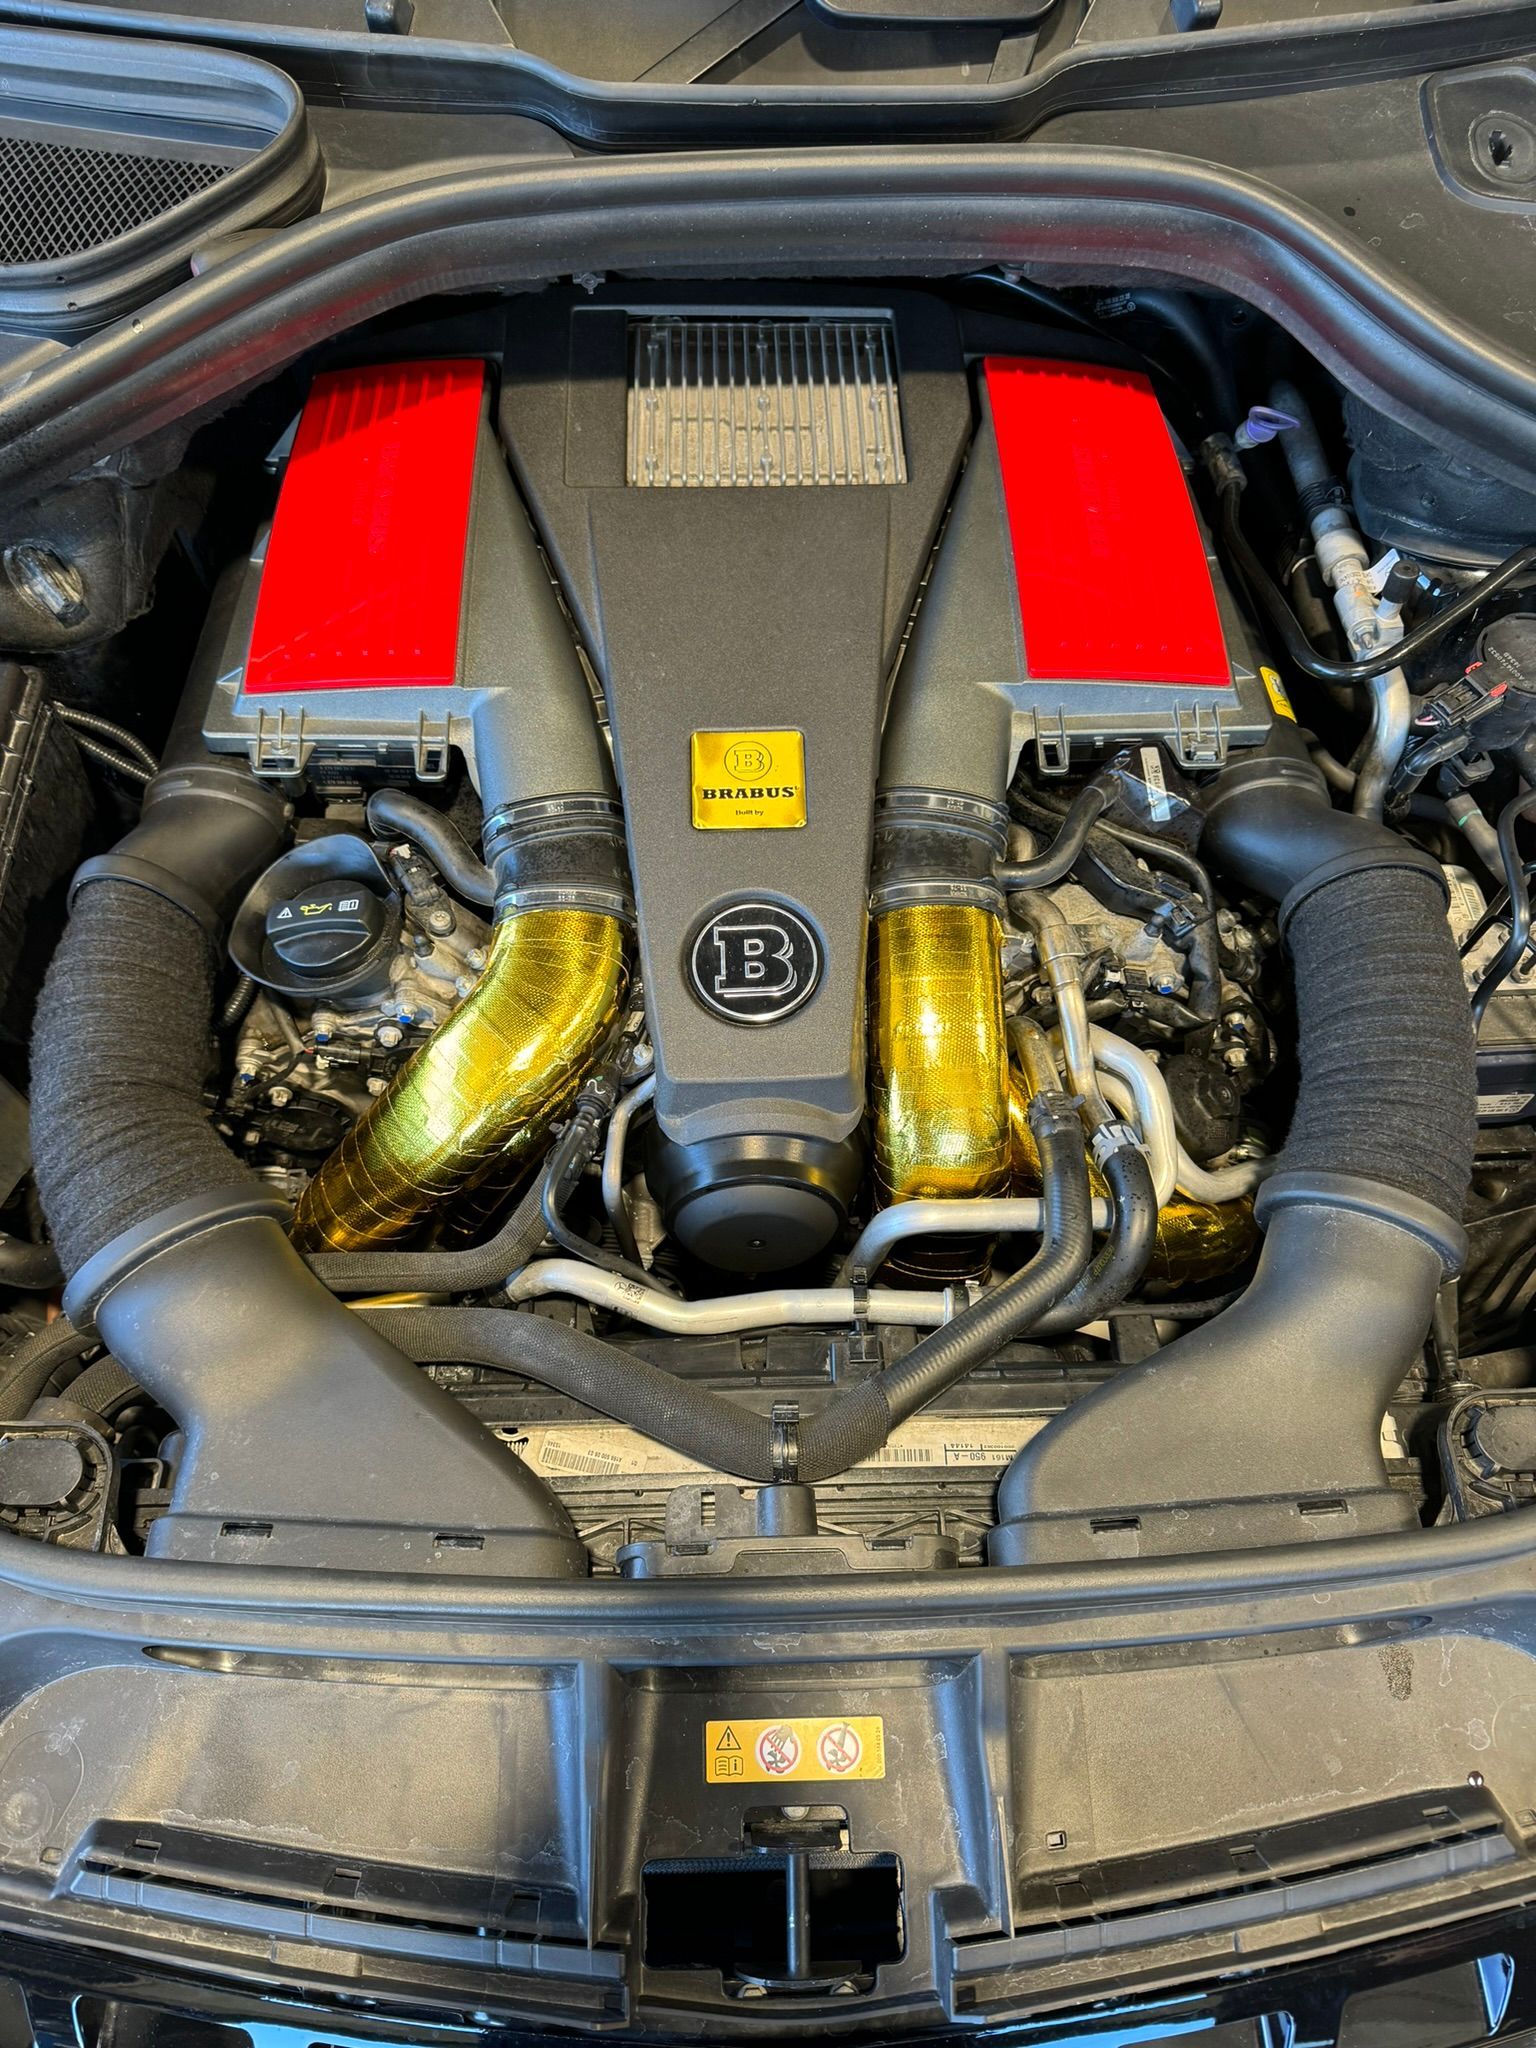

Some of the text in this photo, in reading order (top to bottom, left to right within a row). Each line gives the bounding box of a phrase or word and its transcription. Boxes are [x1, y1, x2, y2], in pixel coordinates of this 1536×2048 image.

[733, 749, 765, 774] B
[702, 786, 795, 800] BRABUS
[754, 809, 764, 817] by
[713, 924, 798, 998] B
